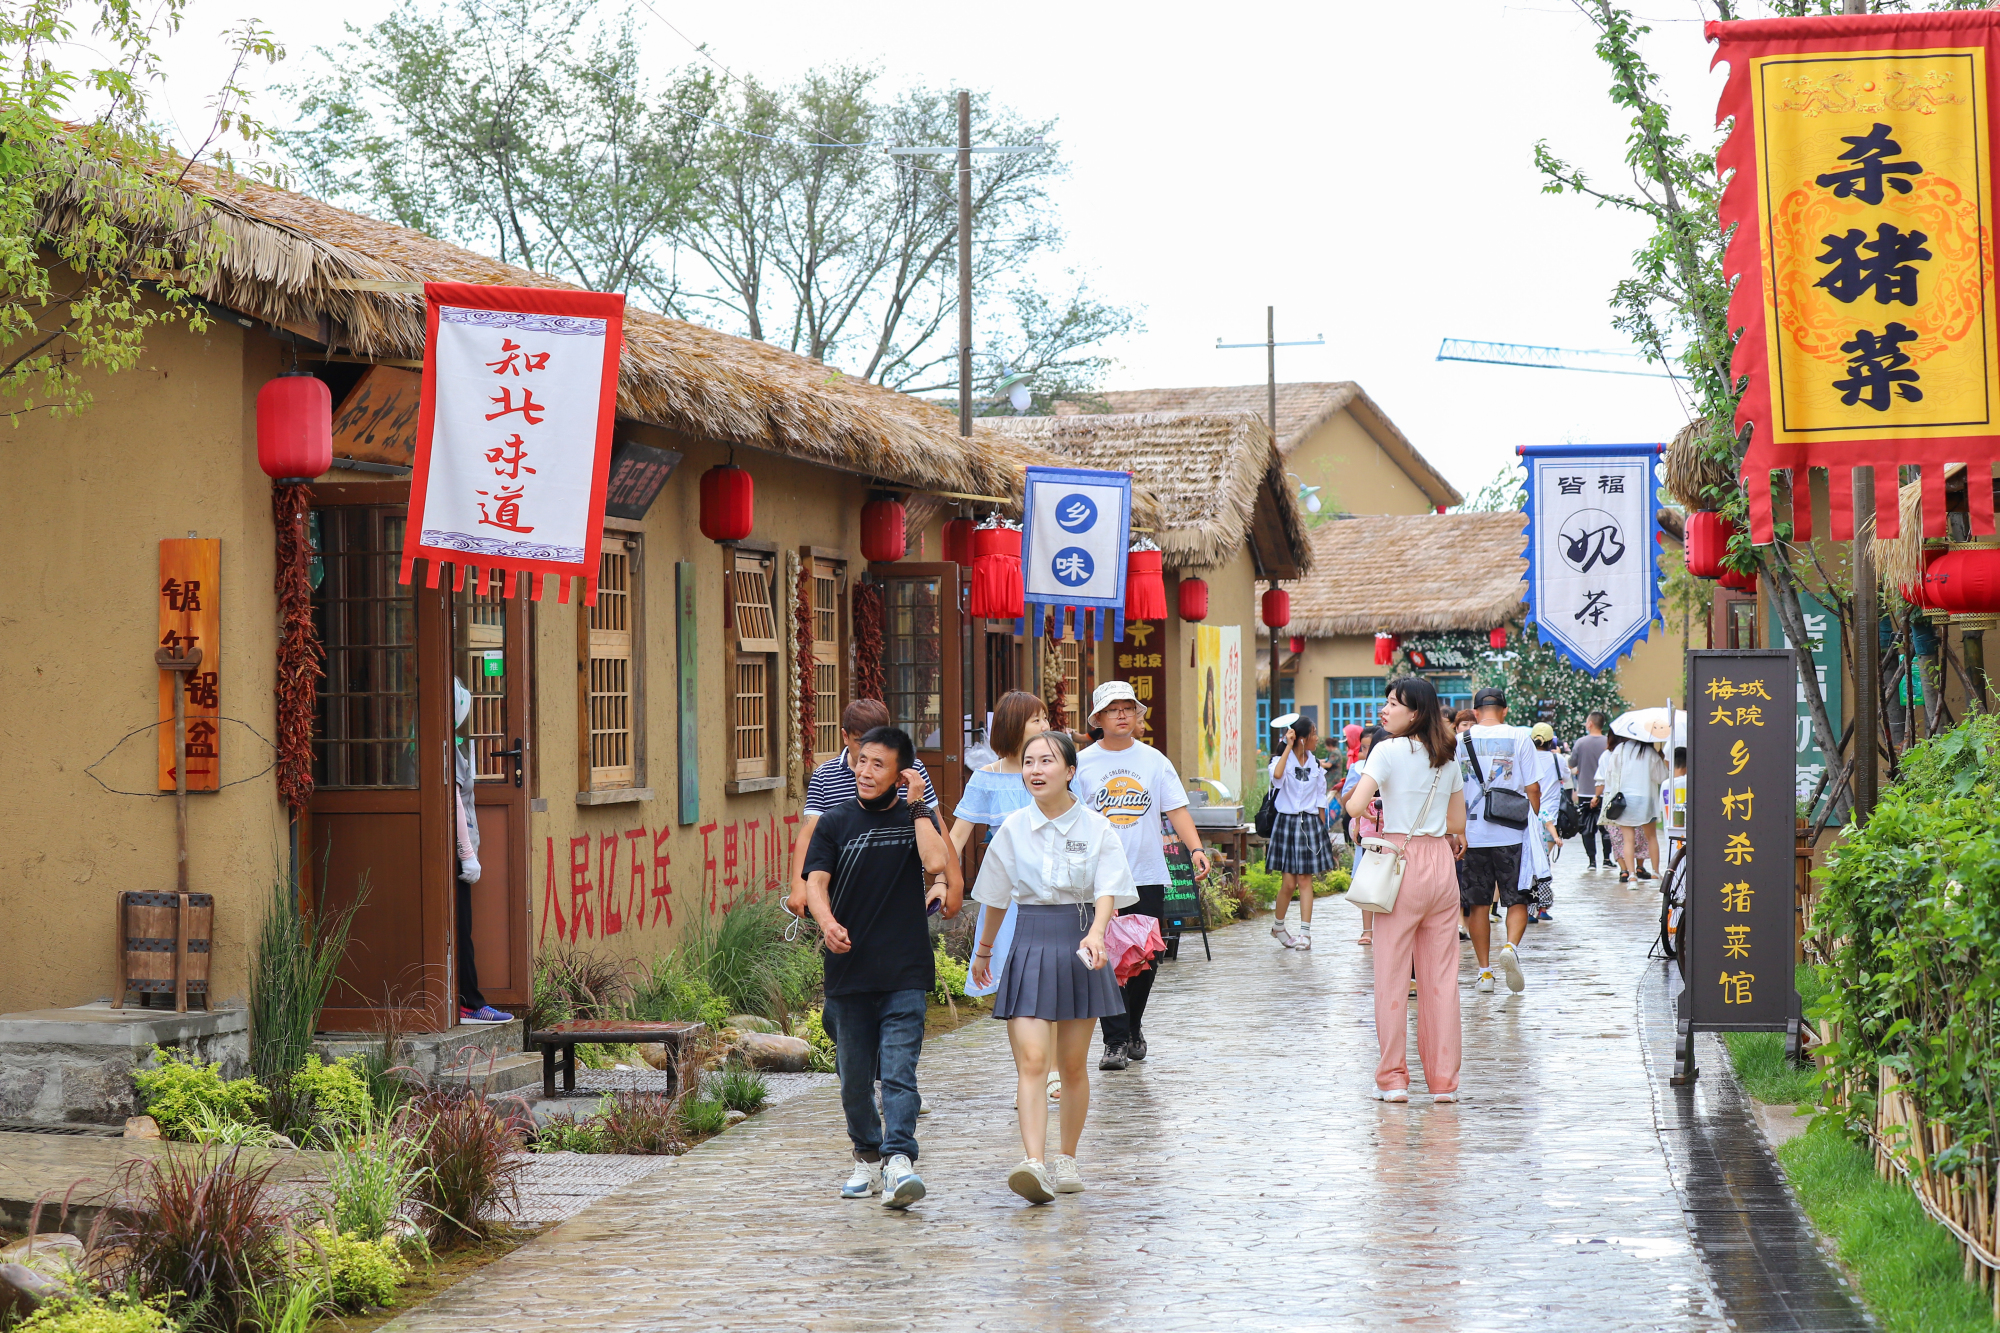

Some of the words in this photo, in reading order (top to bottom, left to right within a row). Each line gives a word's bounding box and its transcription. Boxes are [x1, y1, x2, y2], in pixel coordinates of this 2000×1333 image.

[1812, 123, 1933, 412] 杀猪菜
[332, 383, 420, 452] 知北味
[474, 338, 551, 534] 知北味道
[1558, 475, 1625, 495] 皆福
[1056, 502, 1091, 582] 乡味
[1560, 525, 1625, 628] 奶茶
[489, 662, 499, 671] 推
[1119, 653, 1162, 668] 老北京
[1704, 678, 1772, 701] 梅城
[1708, 705, 1765, 728] 大院
[1094, 786, 1152, 813] Canada
[539, 824, 673, 949] 人民亿万兵
[1718, 739, 1755, 1005] 乡村杀猪菜馆
